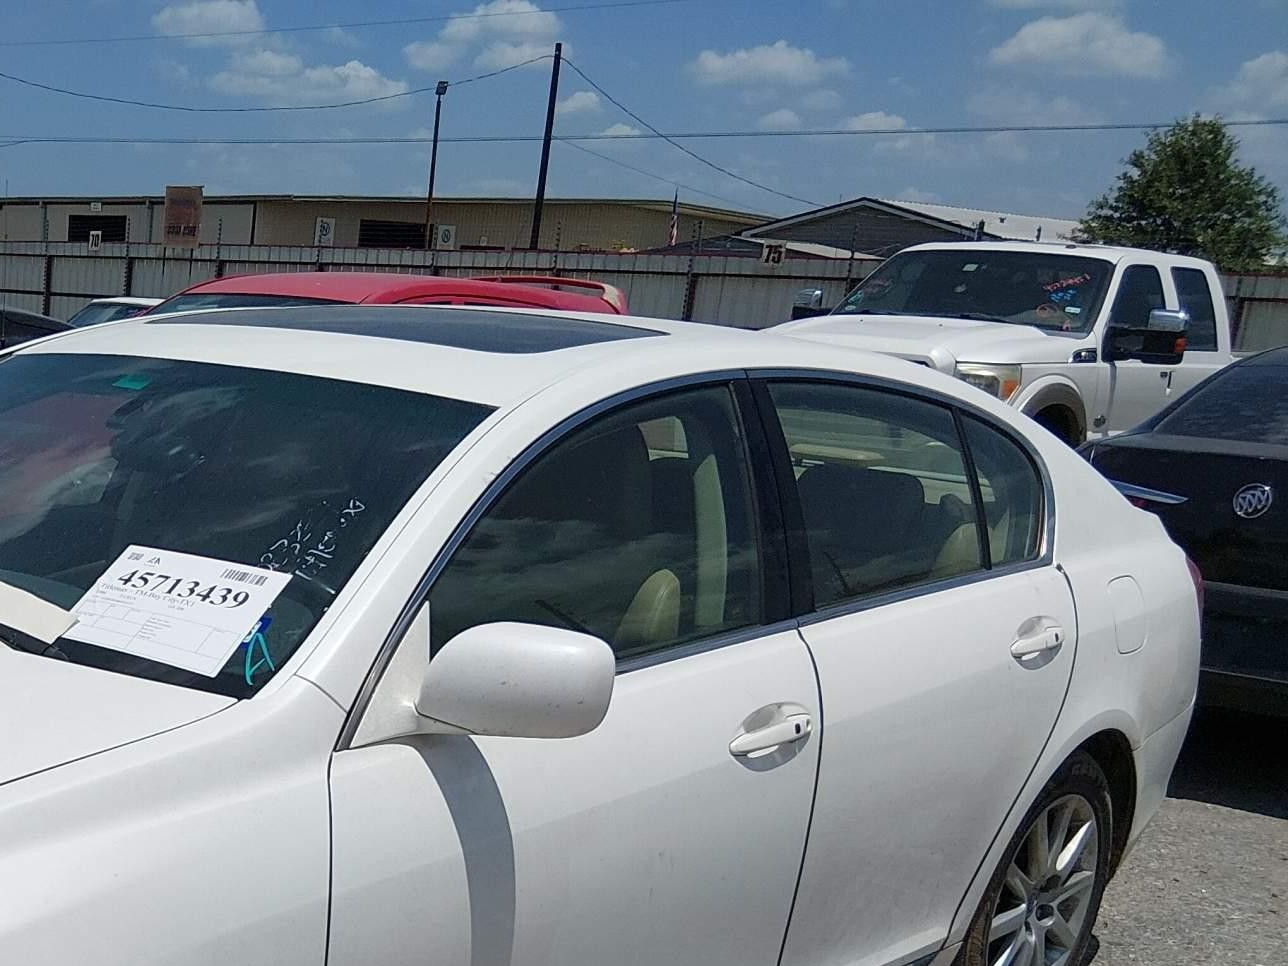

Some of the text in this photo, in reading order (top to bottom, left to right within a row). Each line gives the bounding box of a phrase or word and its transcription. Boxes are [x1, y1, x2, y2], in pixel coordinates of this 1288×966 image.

[90, 233, 100, 248] 70
[765, 244, 783, 263] 75
[117, 569, 250, 608] 45713439
